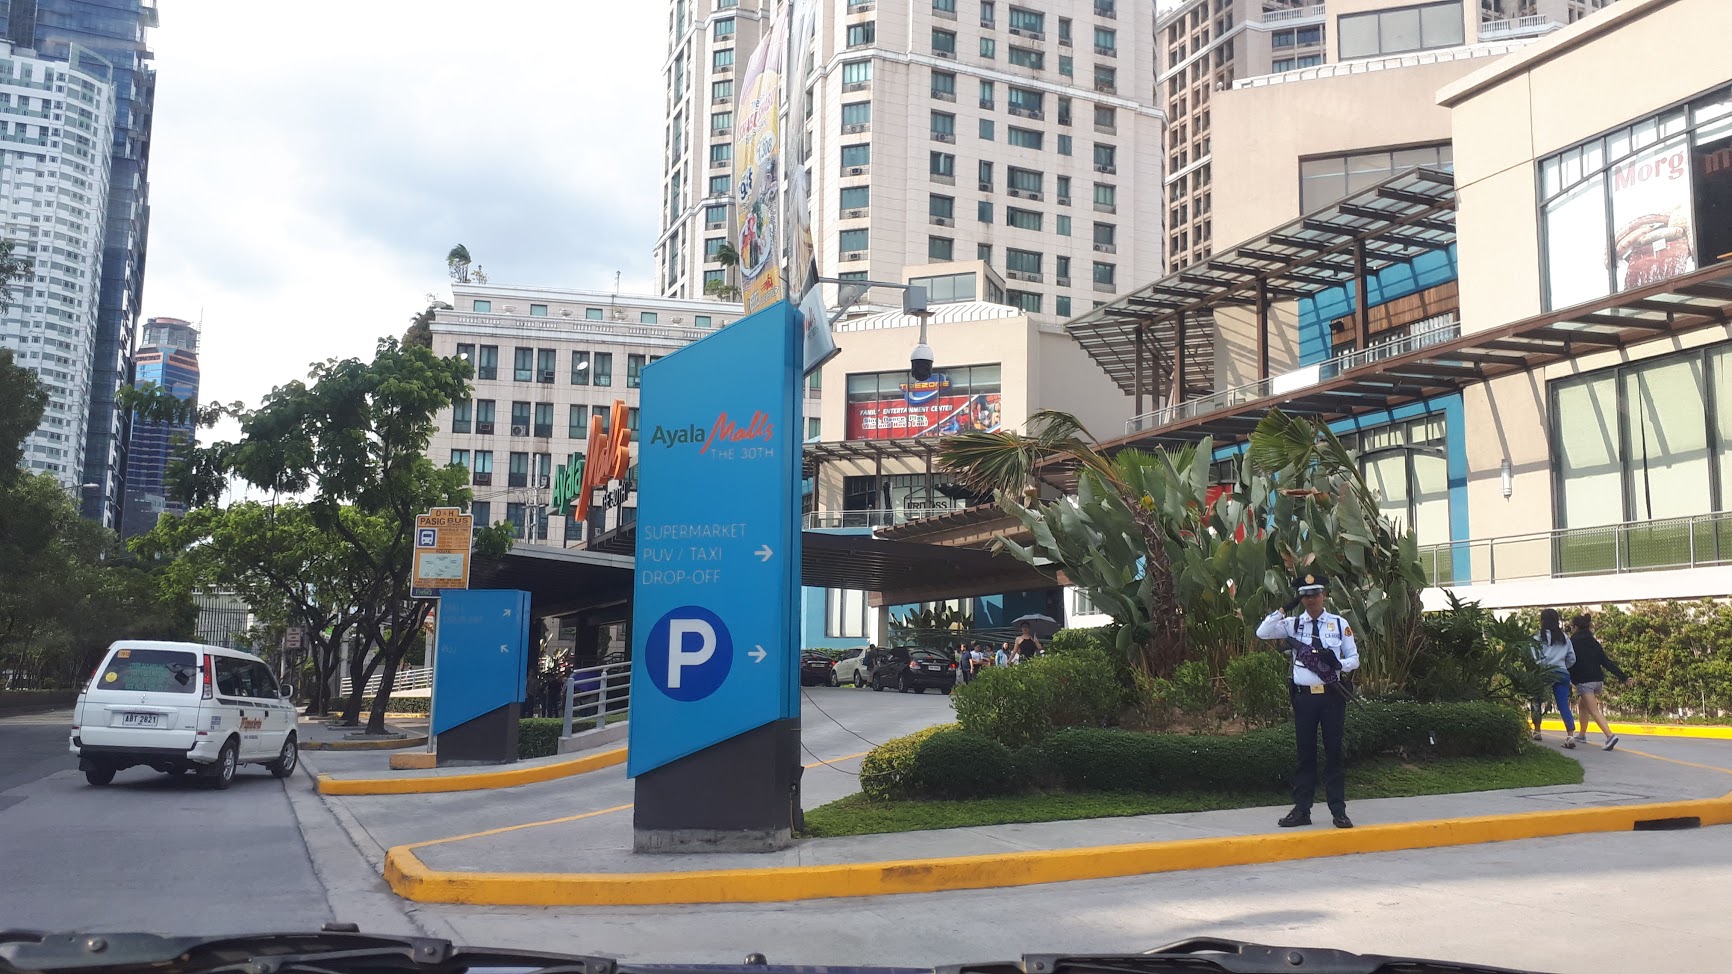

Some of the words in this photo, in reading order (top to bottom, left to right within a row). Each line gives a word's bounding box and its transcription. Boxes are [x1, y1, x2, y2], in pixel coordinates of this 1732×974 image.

[883, 406, 929, 414] ENTERTANMENT
[650, 423, 706, 449] Ayala
[698, 409, 775, 455] Malls
[551, 451, 586, 515] Ayala
[575, 399, 632, 522] Malls
[711, 448, 736, 461] THE
[741, 446, 775, 460] 30TH
[420, 517, 446, 526] PASIG
[644, 523, 748, 541] SUPERMARKET
[642, 547, 674, 563] PUV
[689, 546, 723, 561] TAXI
[641, 569, 721, 585] DROP-OFF
[667, 618, 718, 689] P
[124, 715, 138, 723] ABT
[139, 715, 156, 724] 2821
